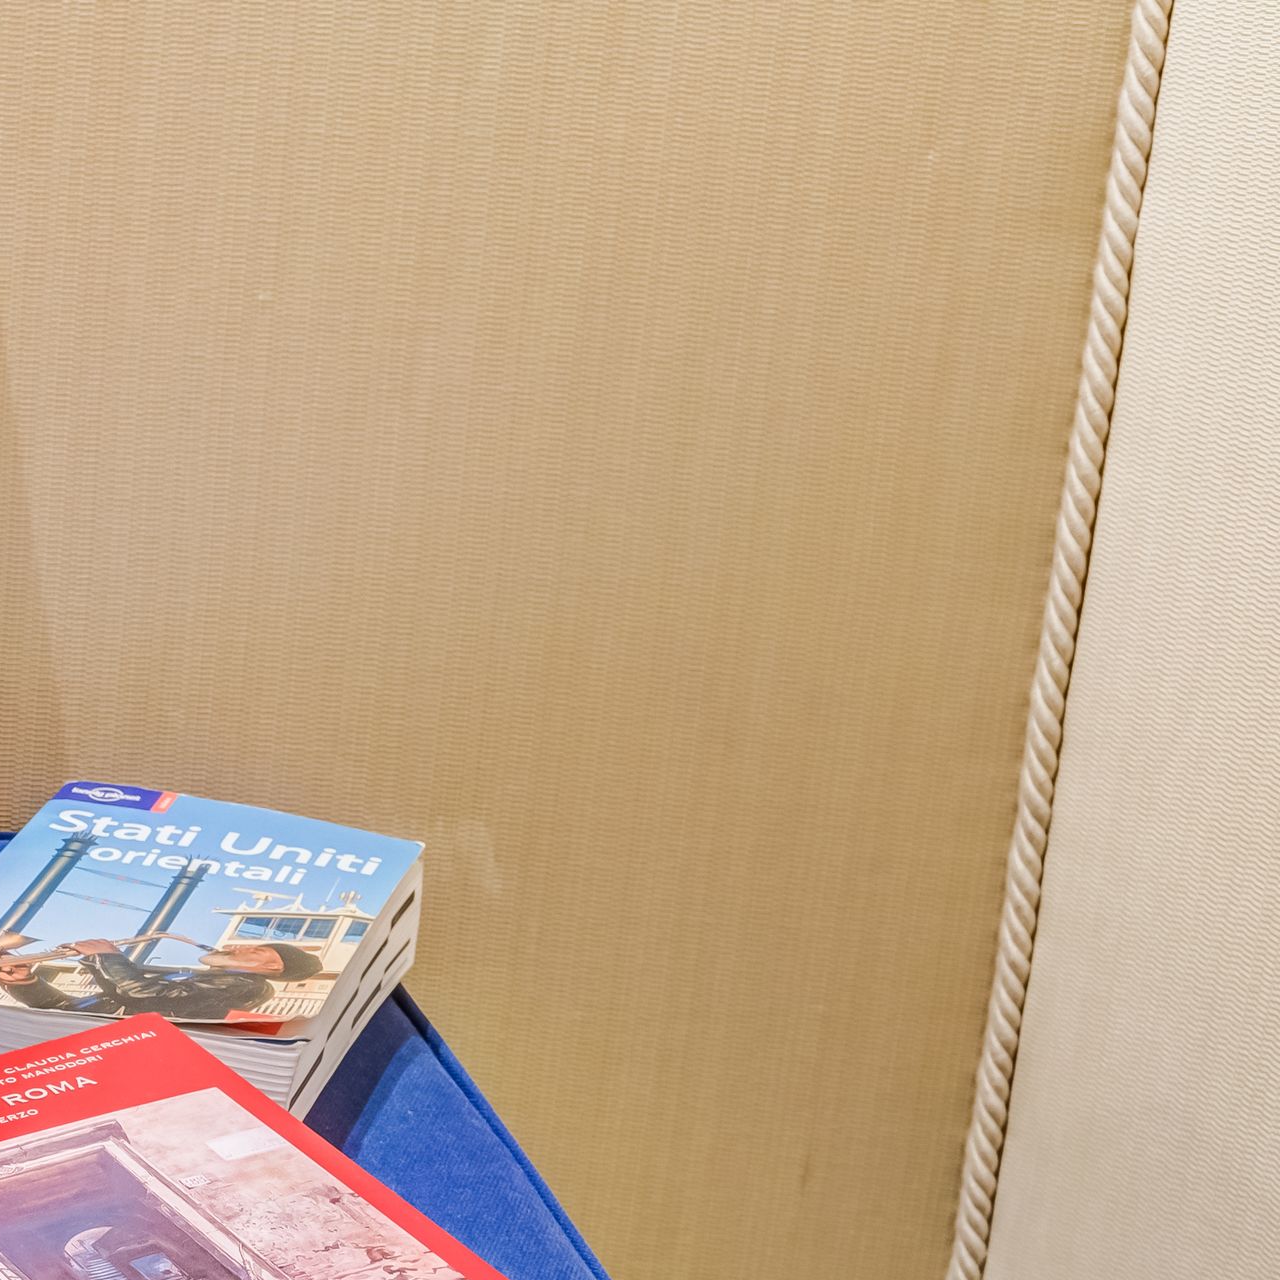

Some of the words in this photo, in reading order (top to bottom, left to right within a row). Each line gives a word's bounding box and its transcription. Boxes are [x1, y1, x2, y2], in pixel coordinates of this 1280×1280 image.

[48, 809, 202, 848] Stati
[220, 830, 382, 876] Uniti
[86, 842, 309, 886] orientali
[2, 1074, 98, 1107] ROMA
